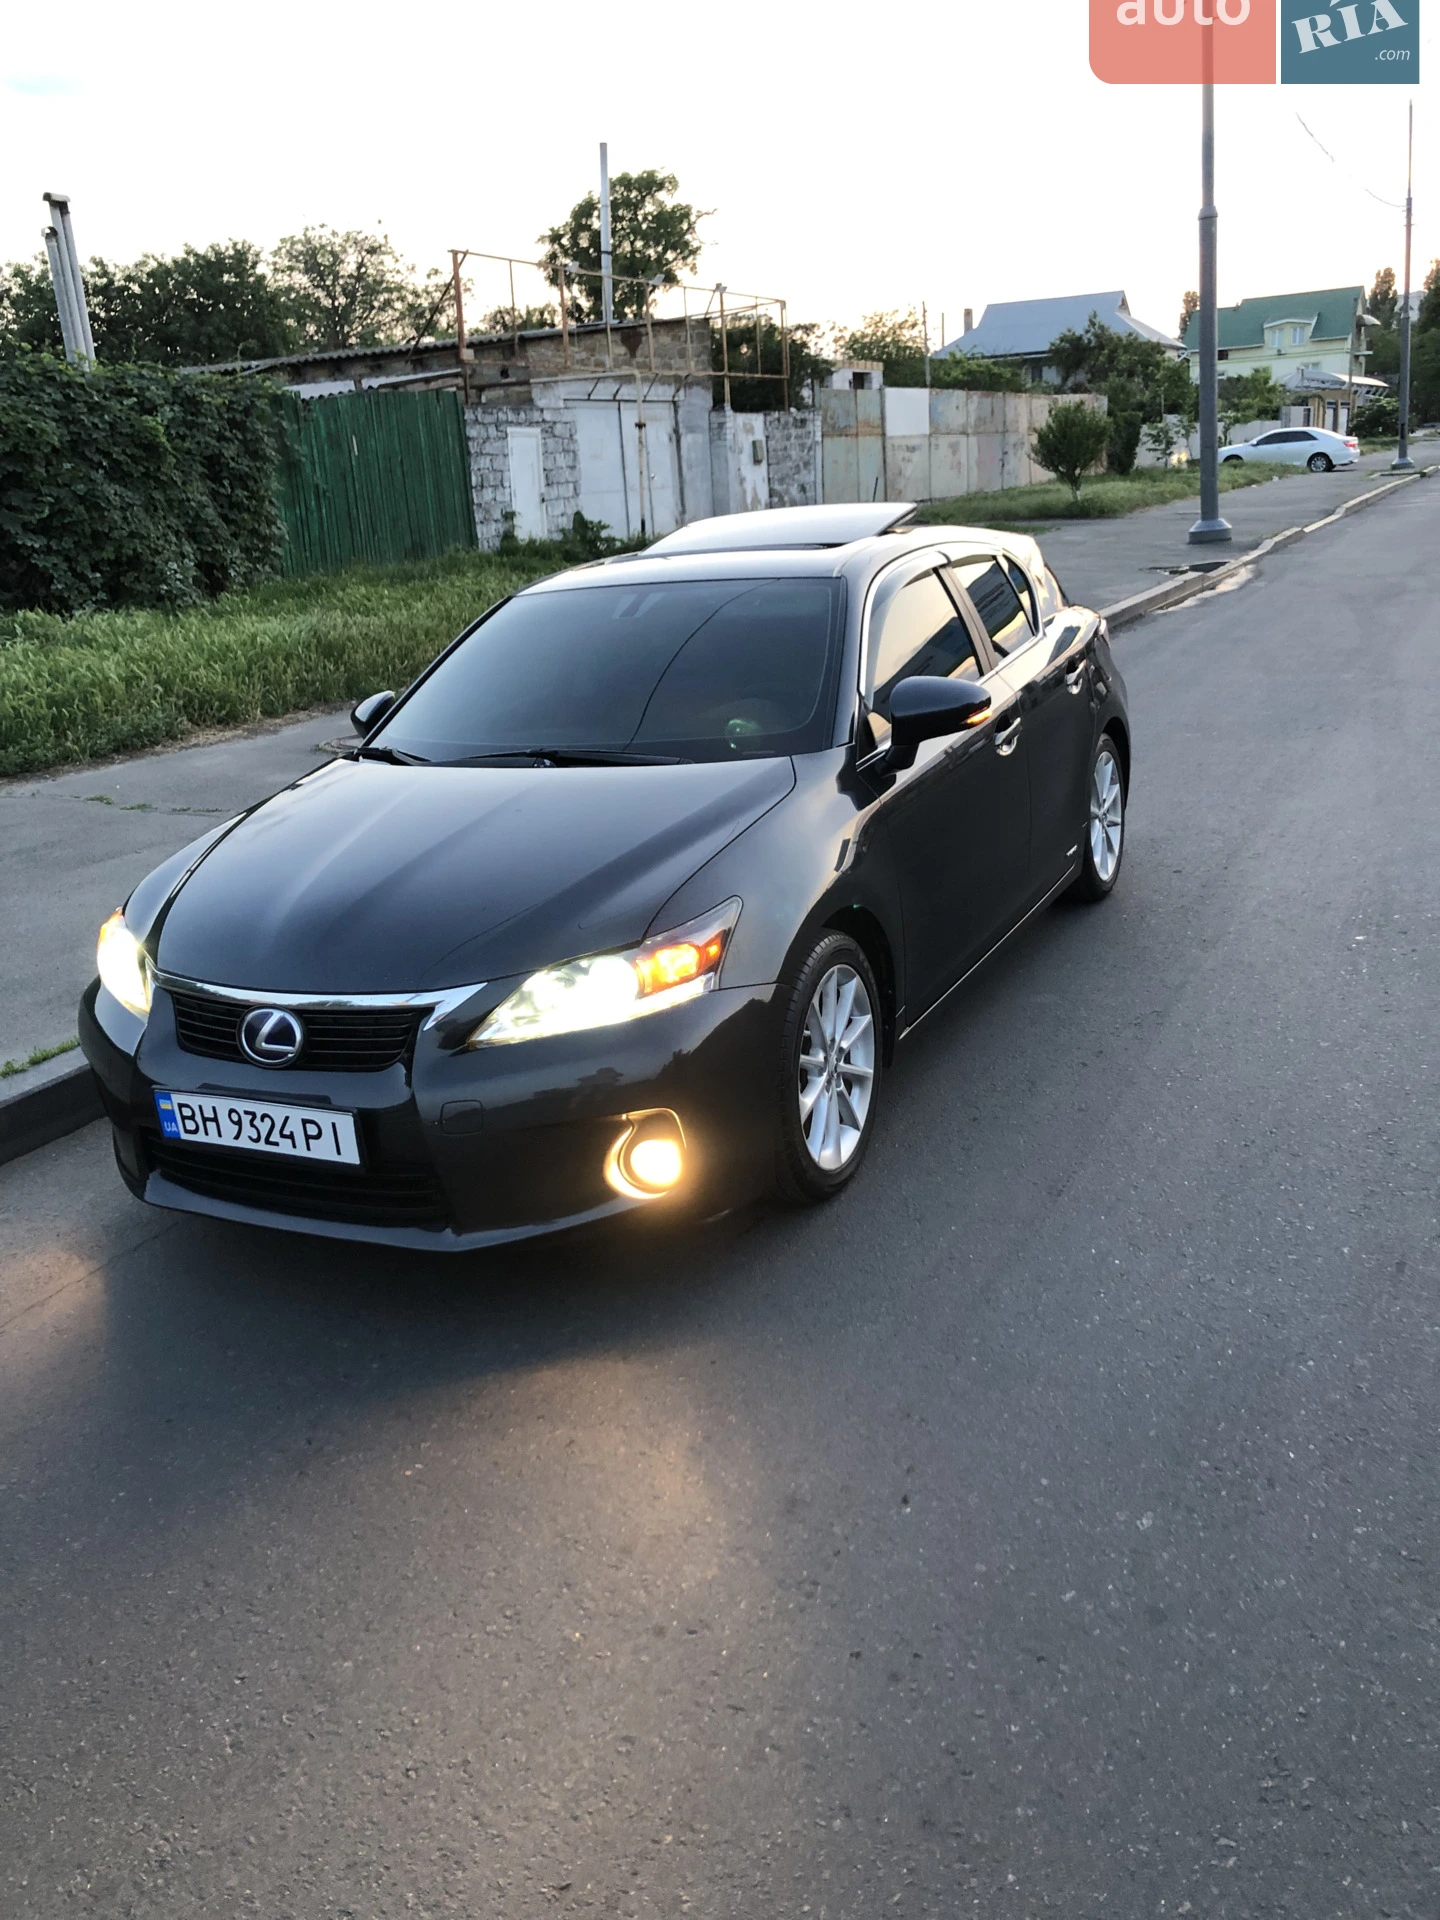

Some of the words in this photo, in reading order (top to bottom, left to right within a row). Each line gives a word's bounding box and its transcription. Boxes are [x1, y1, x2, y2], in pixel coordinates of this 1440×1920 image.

[164, 1121, 178, 1133] UA
[178, 1103, 222, 1138] BH
[228, 1108, 297, 1149] 9324
[301, 1118, 342, 1156] PI
